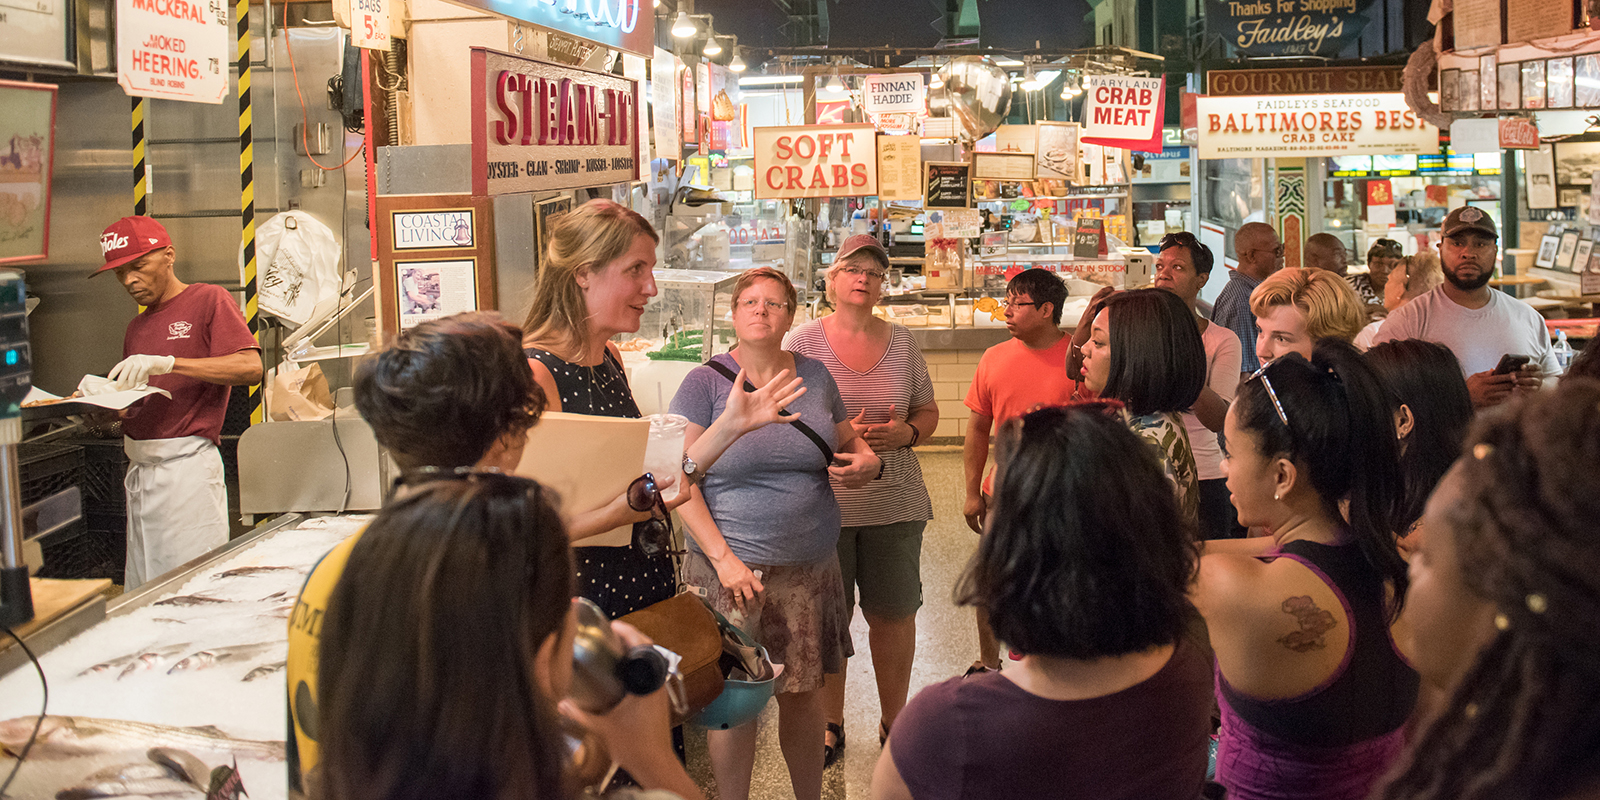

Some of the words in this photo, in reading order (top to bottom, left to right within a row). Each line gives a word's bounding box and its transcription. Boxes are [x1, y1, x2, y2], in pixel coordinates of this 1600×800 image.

[359, 0, 382, 13] BAGS
[1229, 1, 1272, 17] Thanks
[1277, 0, 1294, 13] For
[1300, 0, 1356, 14] Shopping
[1237, 15, 1344, 53] Faidley's
[150, 77, 165, 87] BLIND
[167, 79, 186, 89] ROBINS
[870, 81, 916, 93] FINNAN
[1091, 79, 1159, 89] MARYLAND
[1213, 72, 1334, 95] GOURMET
[873, 94, 914, 105] HADDIE
[1095, 86, 1153, 106] CRAB
[1257, 99, 1319, 109] FAIDLEYS
[1323, 98, 1380, 108] SEAFOOD
[1094, 106, 1151, 126] MEAT
[1208, 111, 1362, 133] BALTIMORES
[776, 132, 854, 160] SOFT
[1282, 133, 1316, 144] CRAB
[1322, 132, 1356, 143] CAKE
[526, 160, 548, 177] CLAM
[766, 163, 868, 191] CRABS
[401, 213, 463, 229] COASTAL
[402, 227, 455, 242] LIVING
[100, 233, 129, 256] rioles
[1061, 265, 1085, 273] MEAT
[1087, 264, 1096, 273] IN
[1098, 264, 1126, 273] STOCK
